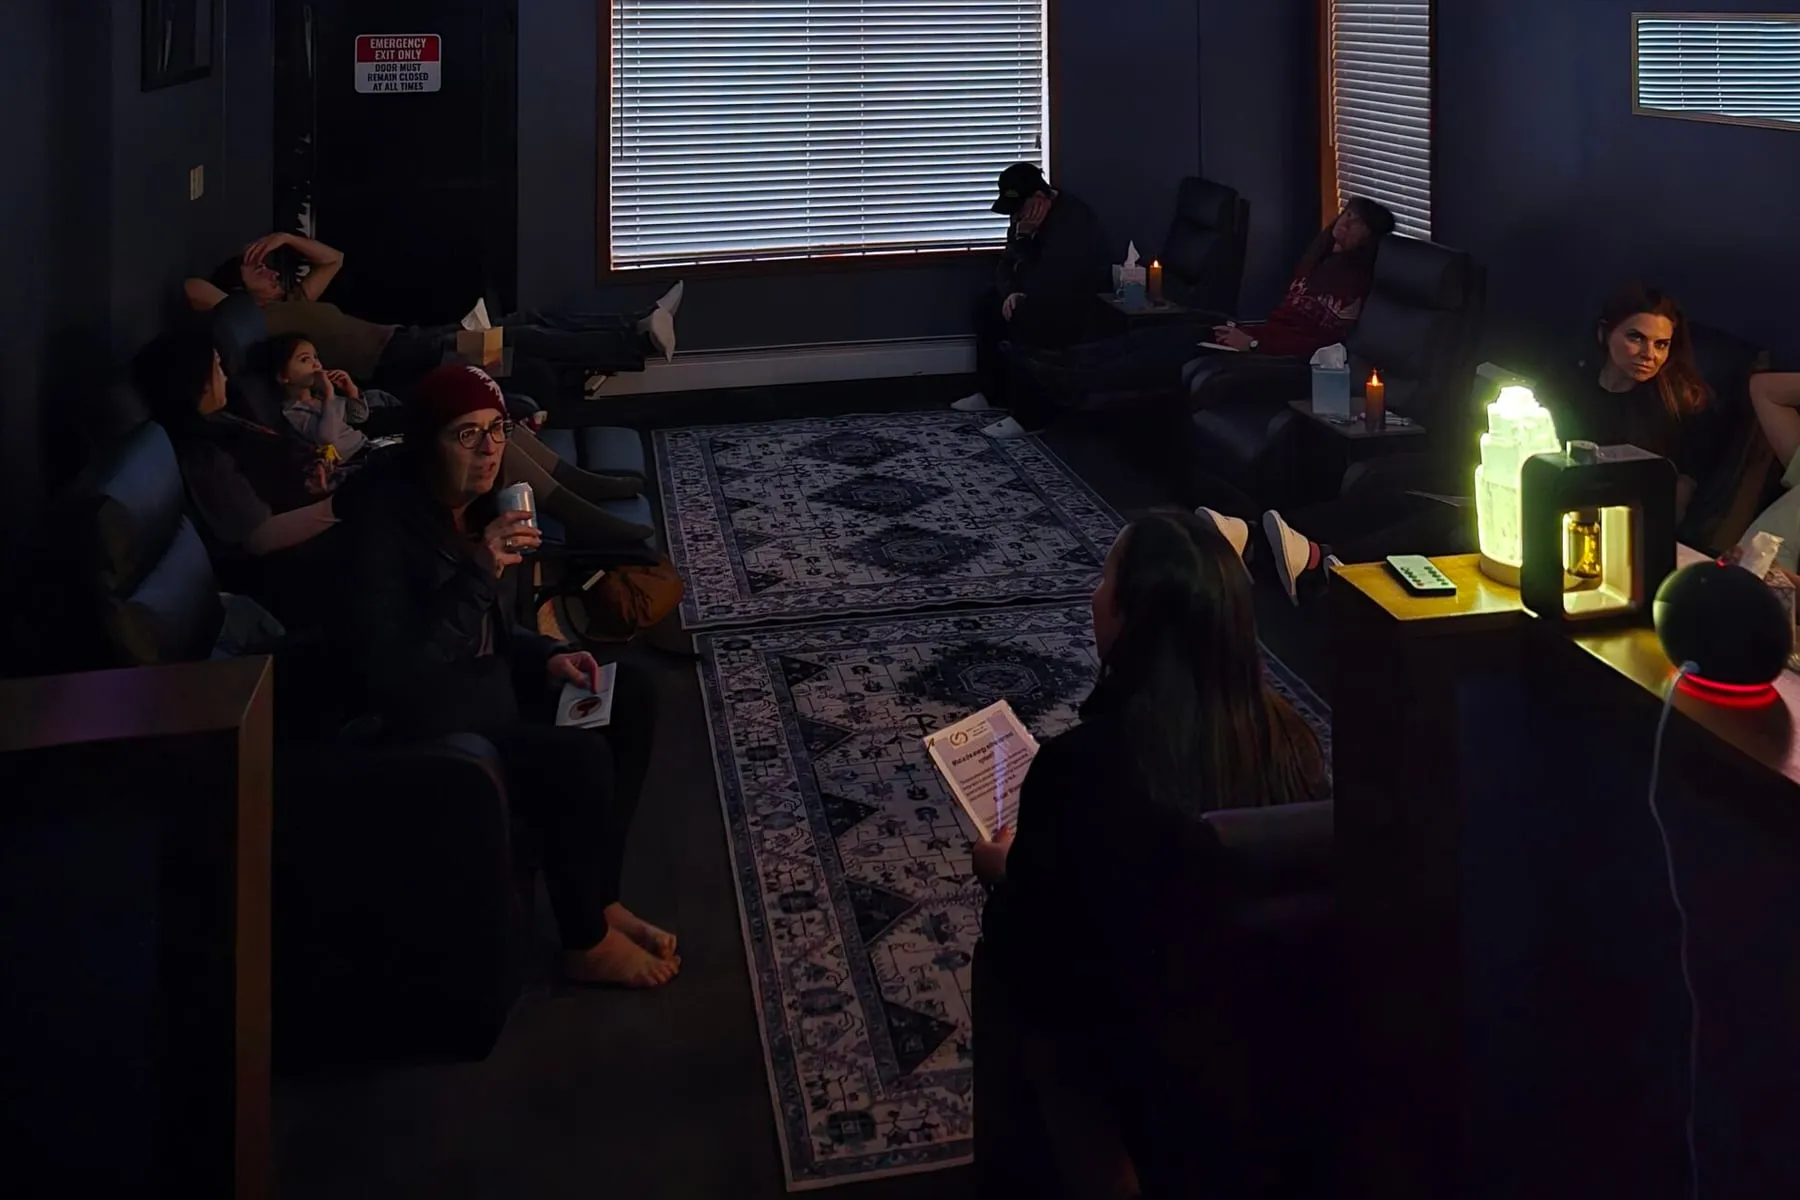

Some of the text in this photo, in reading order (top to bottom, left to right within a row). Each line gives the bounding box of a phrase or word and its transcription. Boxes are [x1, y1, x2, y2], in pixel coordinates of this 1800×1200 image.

[370, 37, 427, 49] EMERGENCY
[375, 49, 422, 60] EXIT ONLY
[375, 63, 421, 73] DOOR MUST
[367, 72, 429, 82] REMAIN CLOSED
[373, 82, 424, 91] AT ALL TIMES
